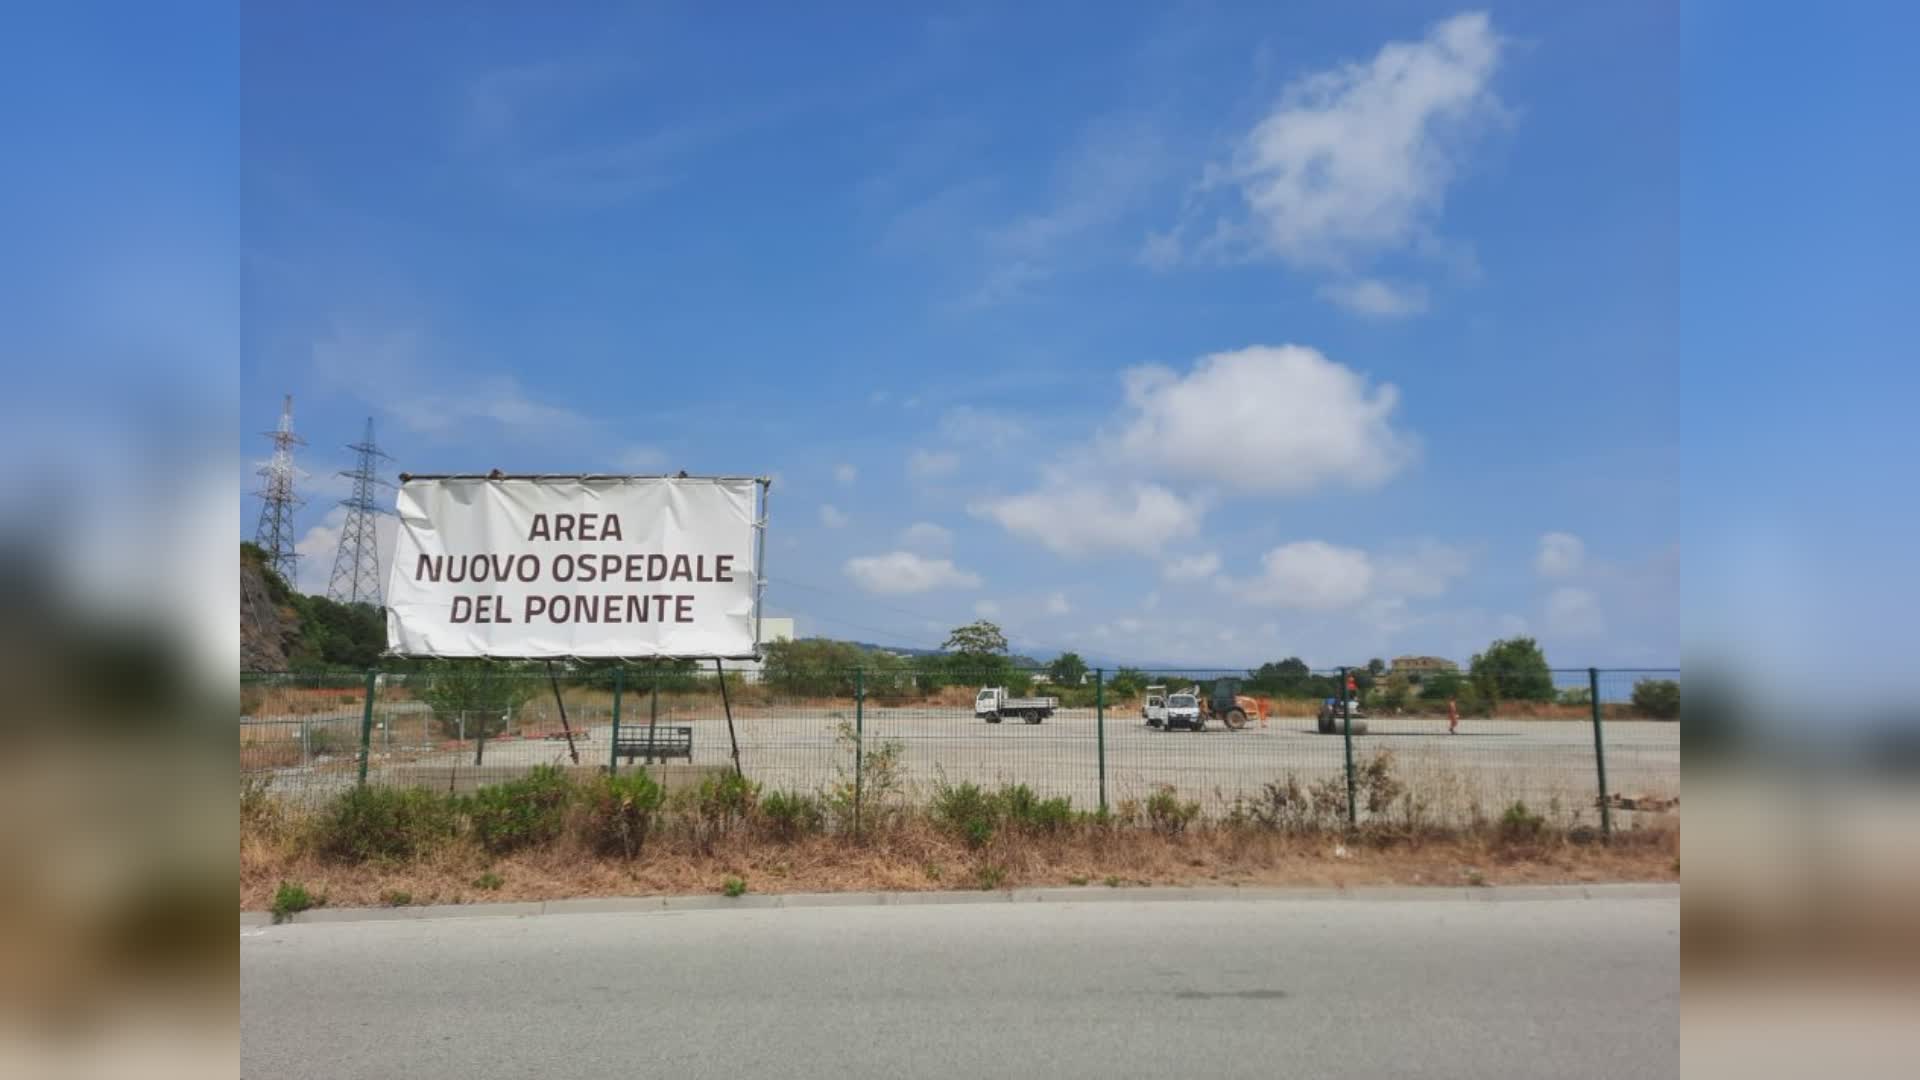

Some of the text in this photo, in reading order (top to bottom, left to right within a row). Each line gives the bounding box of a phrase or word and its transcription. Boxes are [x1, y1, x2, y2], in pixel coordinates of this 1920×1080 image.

[528, 513, 622, 542] AREA
[416, 553, 734, 583] NUOVO OSPEDALE
[450, 594, 695, 624] DEL PONENTE
